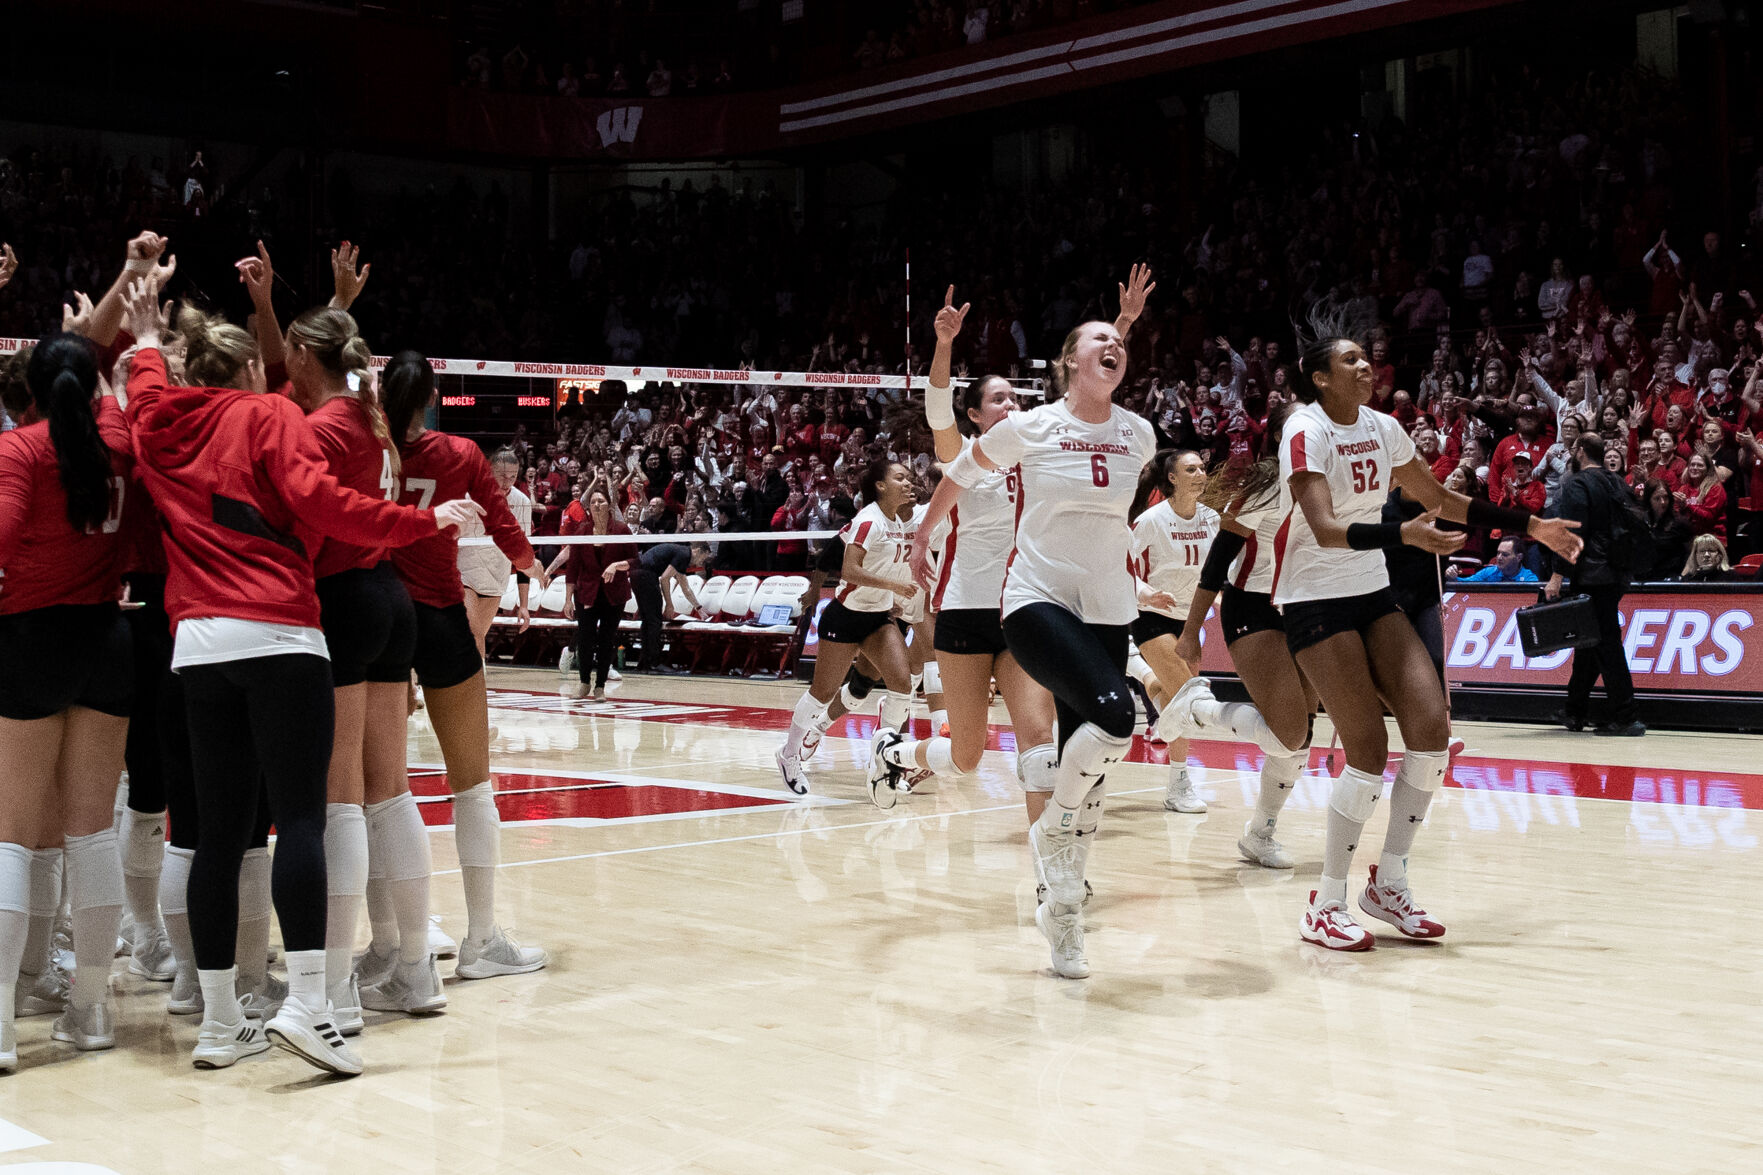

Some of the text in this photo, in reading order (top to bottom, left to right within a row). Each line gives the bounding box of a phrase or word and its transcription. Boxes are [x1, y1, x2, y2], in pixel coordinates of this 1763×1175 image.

[514, 362, 606, 376] WISCONSIN BADGERS
[666, 368, 750, 382] WISCONSIN BADGERS
[805, 373, 881, 385] WISCONSIN BADGERS
[517, 396, 551, 407] HUSKERS
[1335, 438, 1380, 456] WSCOSIN
[1090, 453, 1110, 488] 6
[1350, 458, 1380, 494] 52
[405, 477, 437, 511] 7
[1170, 530, 1209, 541] WISCONSIN
[1184, 544, 1199, 566] 11
[1446, 606, 1755, 677] BAERS
